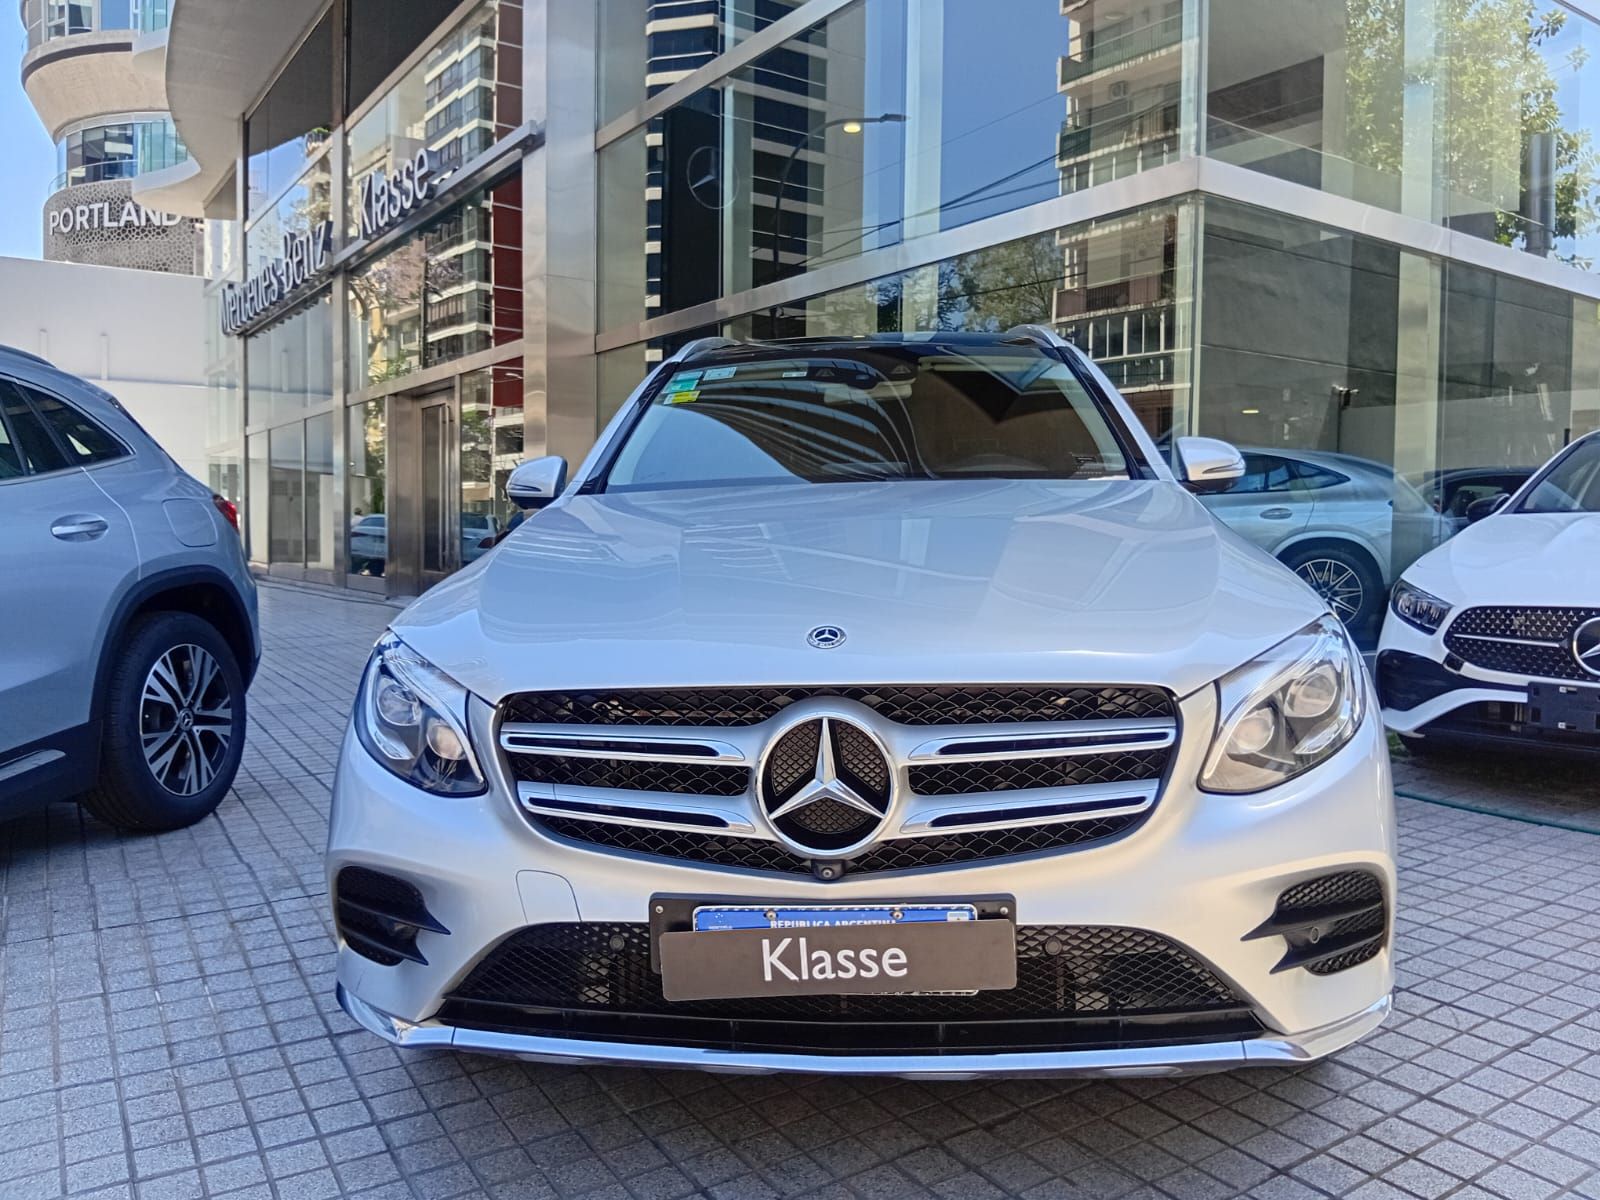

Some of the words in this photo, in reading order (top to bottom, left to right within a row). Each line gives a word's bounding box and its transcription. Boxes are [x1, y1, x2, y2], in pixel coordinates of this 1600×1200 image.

[49, 201, 182, 236] PORTLAND
[220, 220, 327, 335] Mercedes-Benz
[358, 147, 429, 240] Klasse
[761, 937, 908, 982] Klasse
